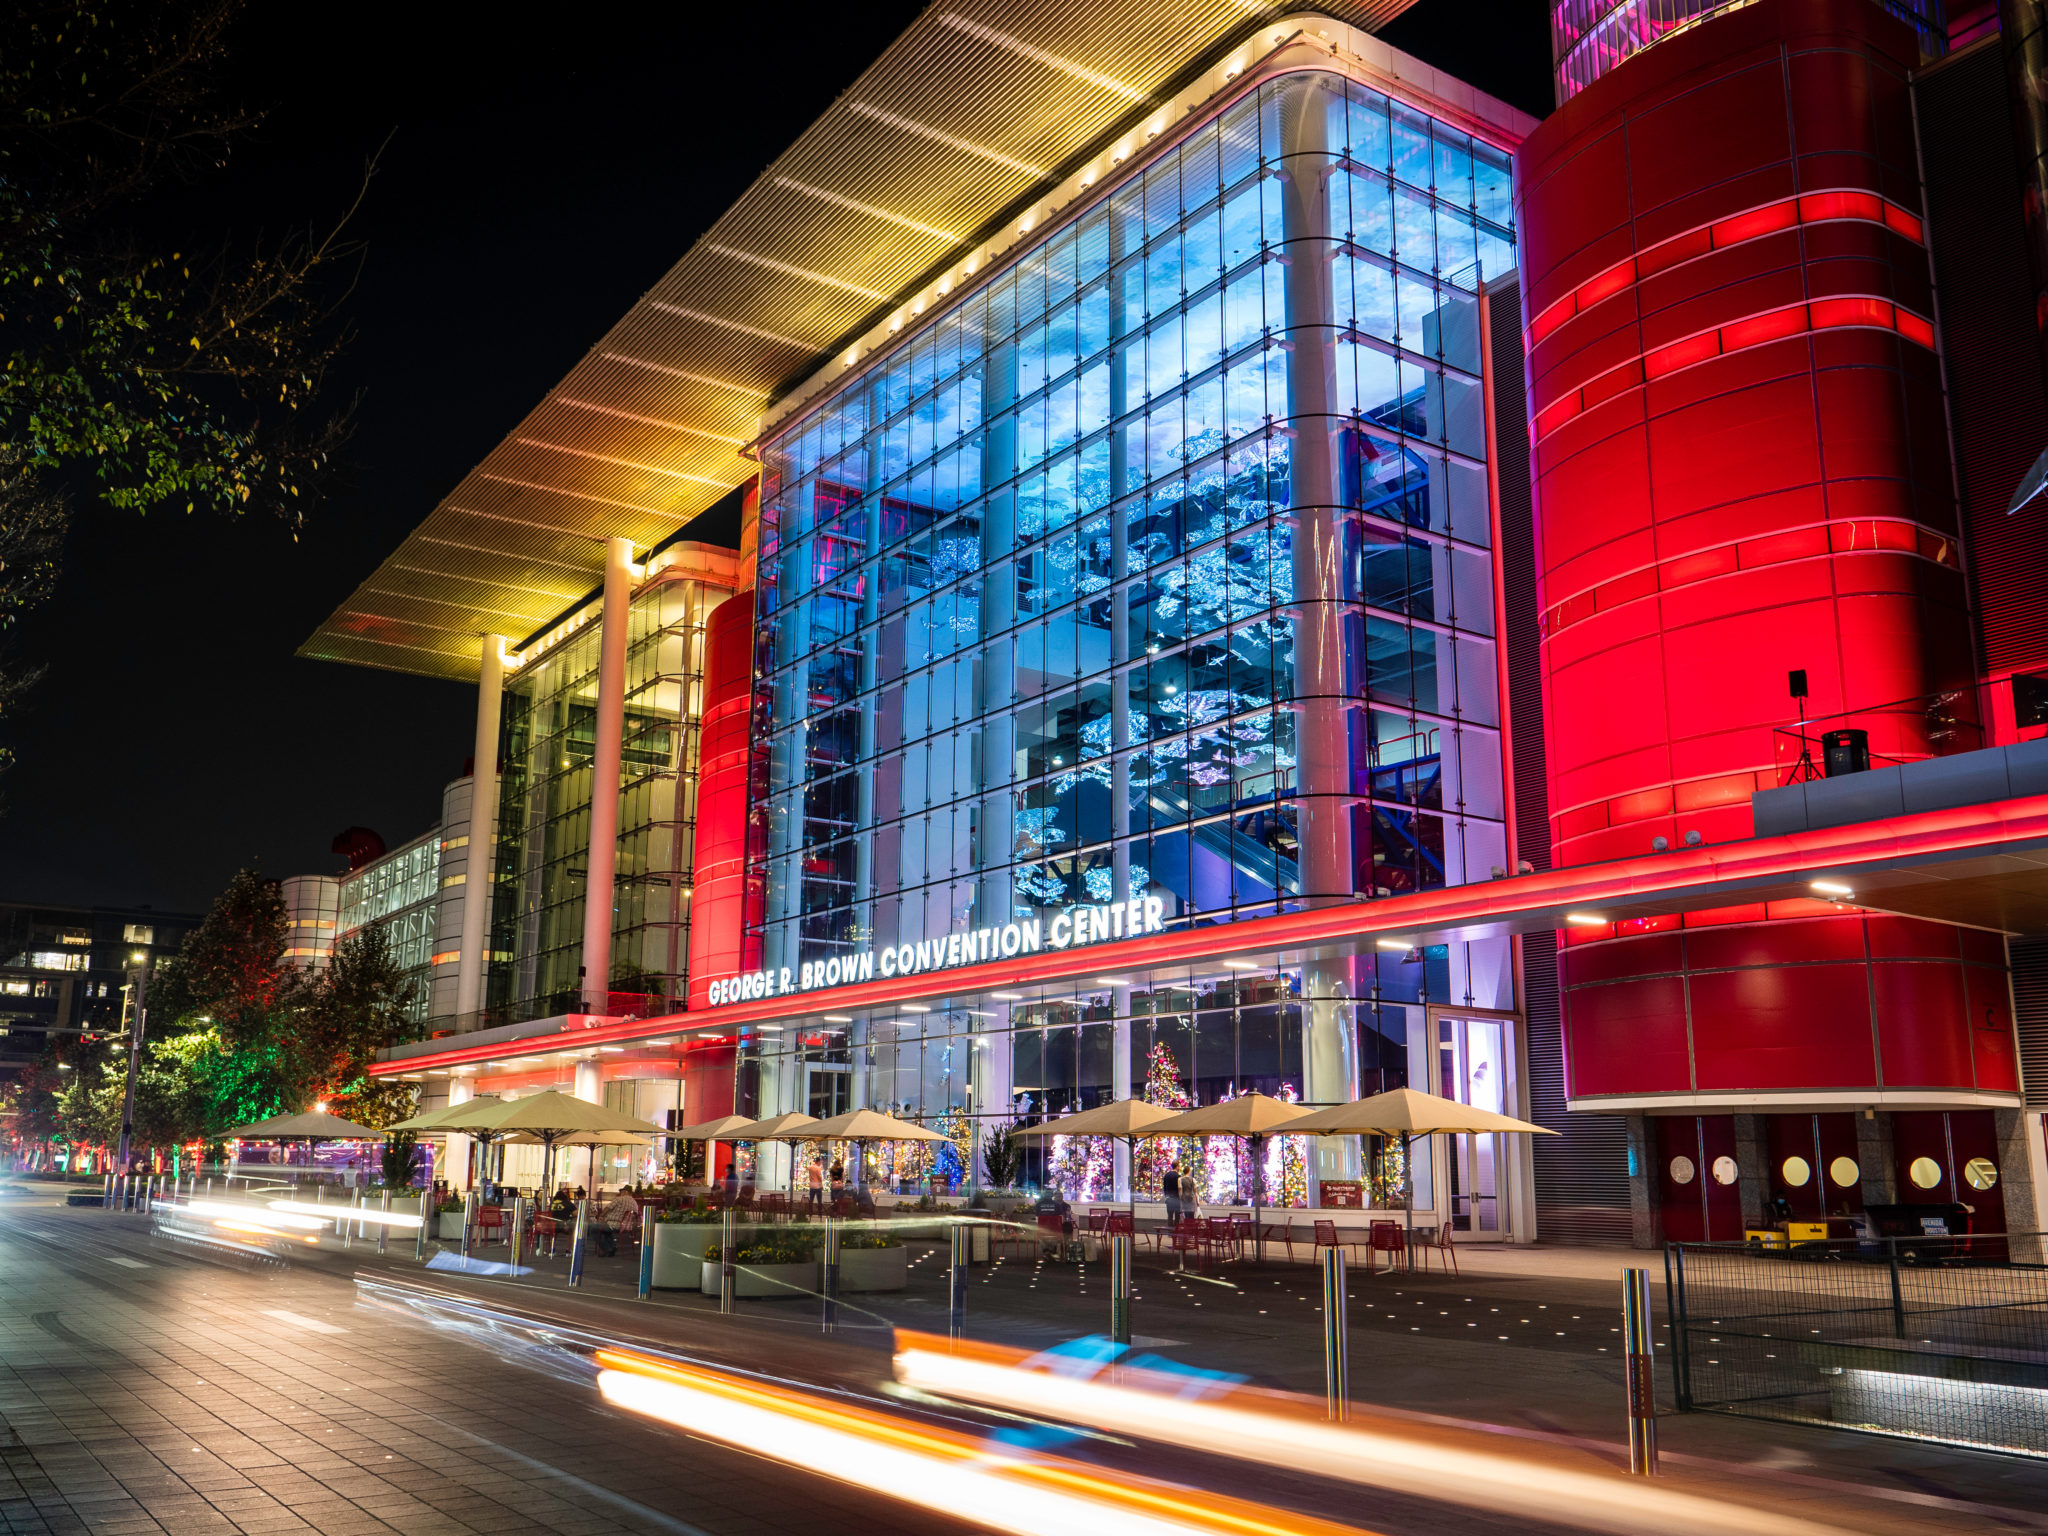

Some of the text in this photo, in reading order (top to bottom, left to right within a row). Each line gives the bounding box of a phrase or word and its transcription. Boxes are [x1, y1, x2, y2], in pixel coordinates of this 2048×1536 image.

[709, 896, 1164, 1005] GEORGE R. BROWN CONVENTION CENTER
